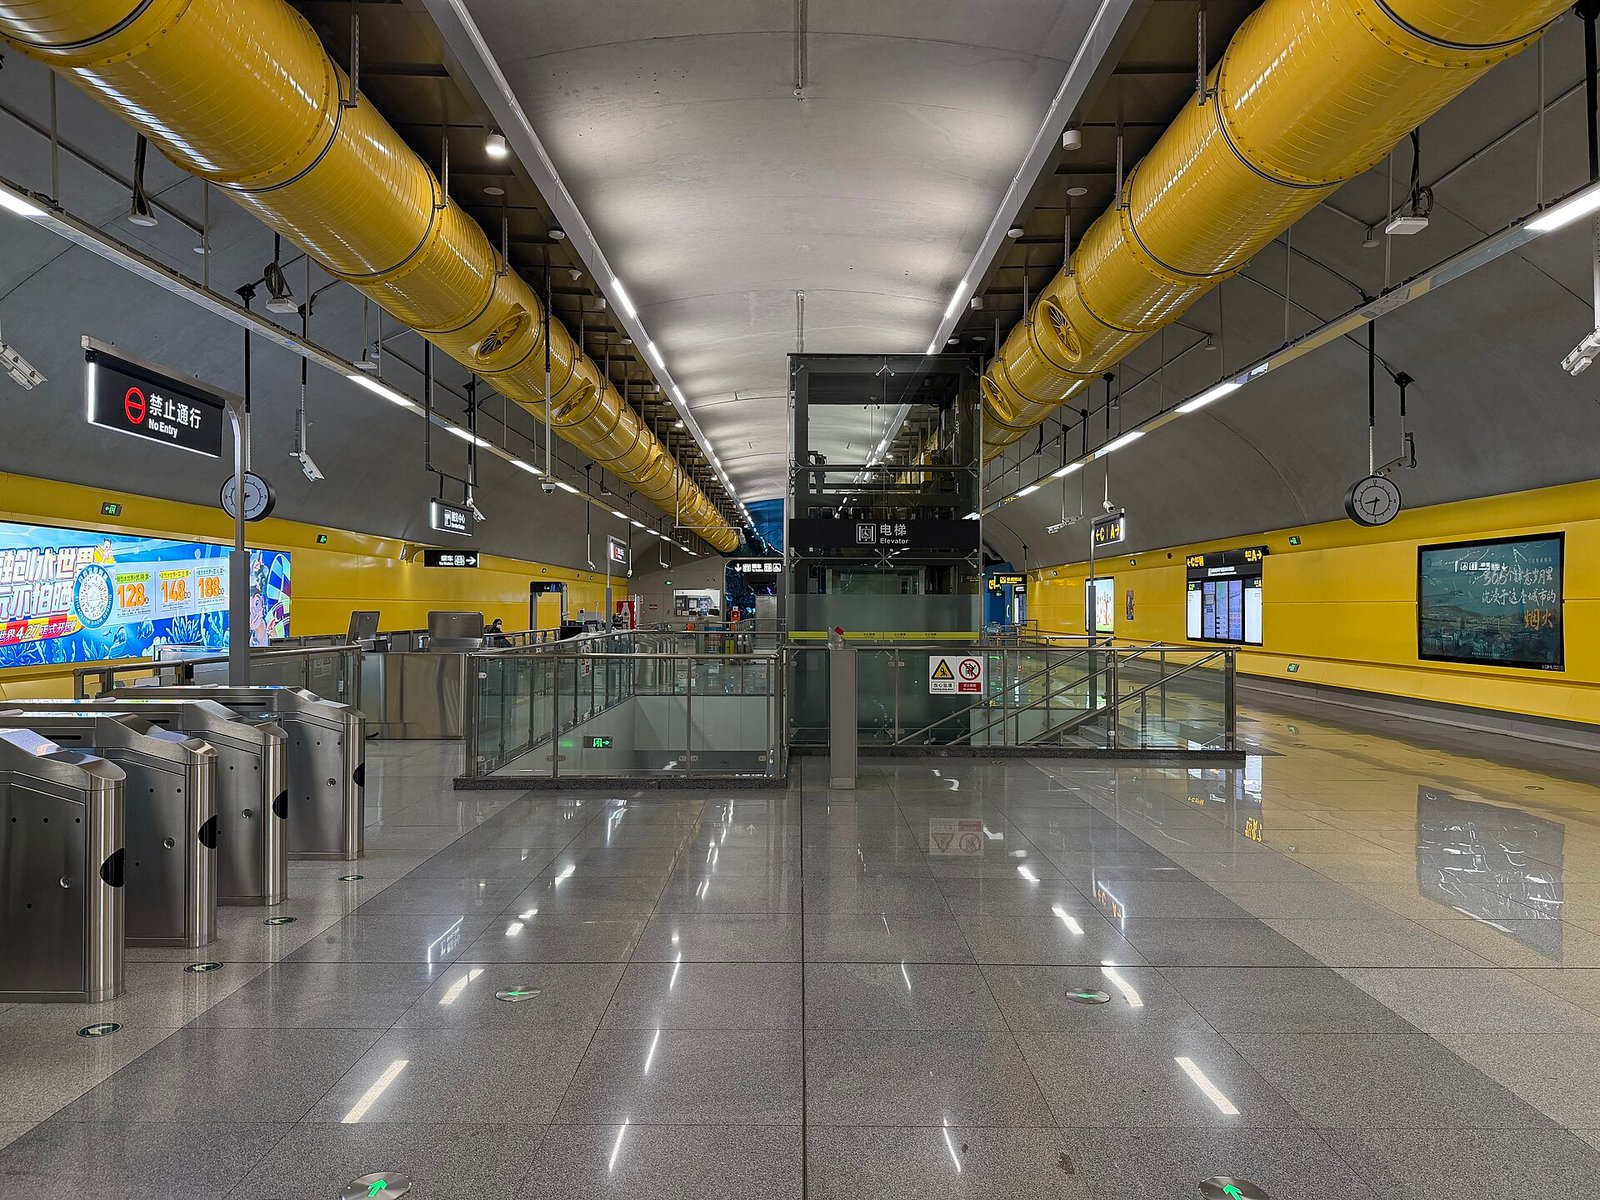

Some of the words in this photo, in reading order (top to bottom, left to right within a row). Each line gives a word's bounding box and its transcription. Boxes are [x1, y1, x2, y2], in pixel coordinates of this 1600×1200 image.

[149, 393, 202, 429] 禁止通行
[148, 418, 158, 431] No
[159, 421, 178, 438] Entry
[880, 524, 907, 536] 电梯
[1100, 527, 1105, 541] C
[1110, 524, 1116, 539] A
[1481, 587, 1557, 607] 沉浸于这座城市的
[1524, 608, 1553, 631] 烟火
